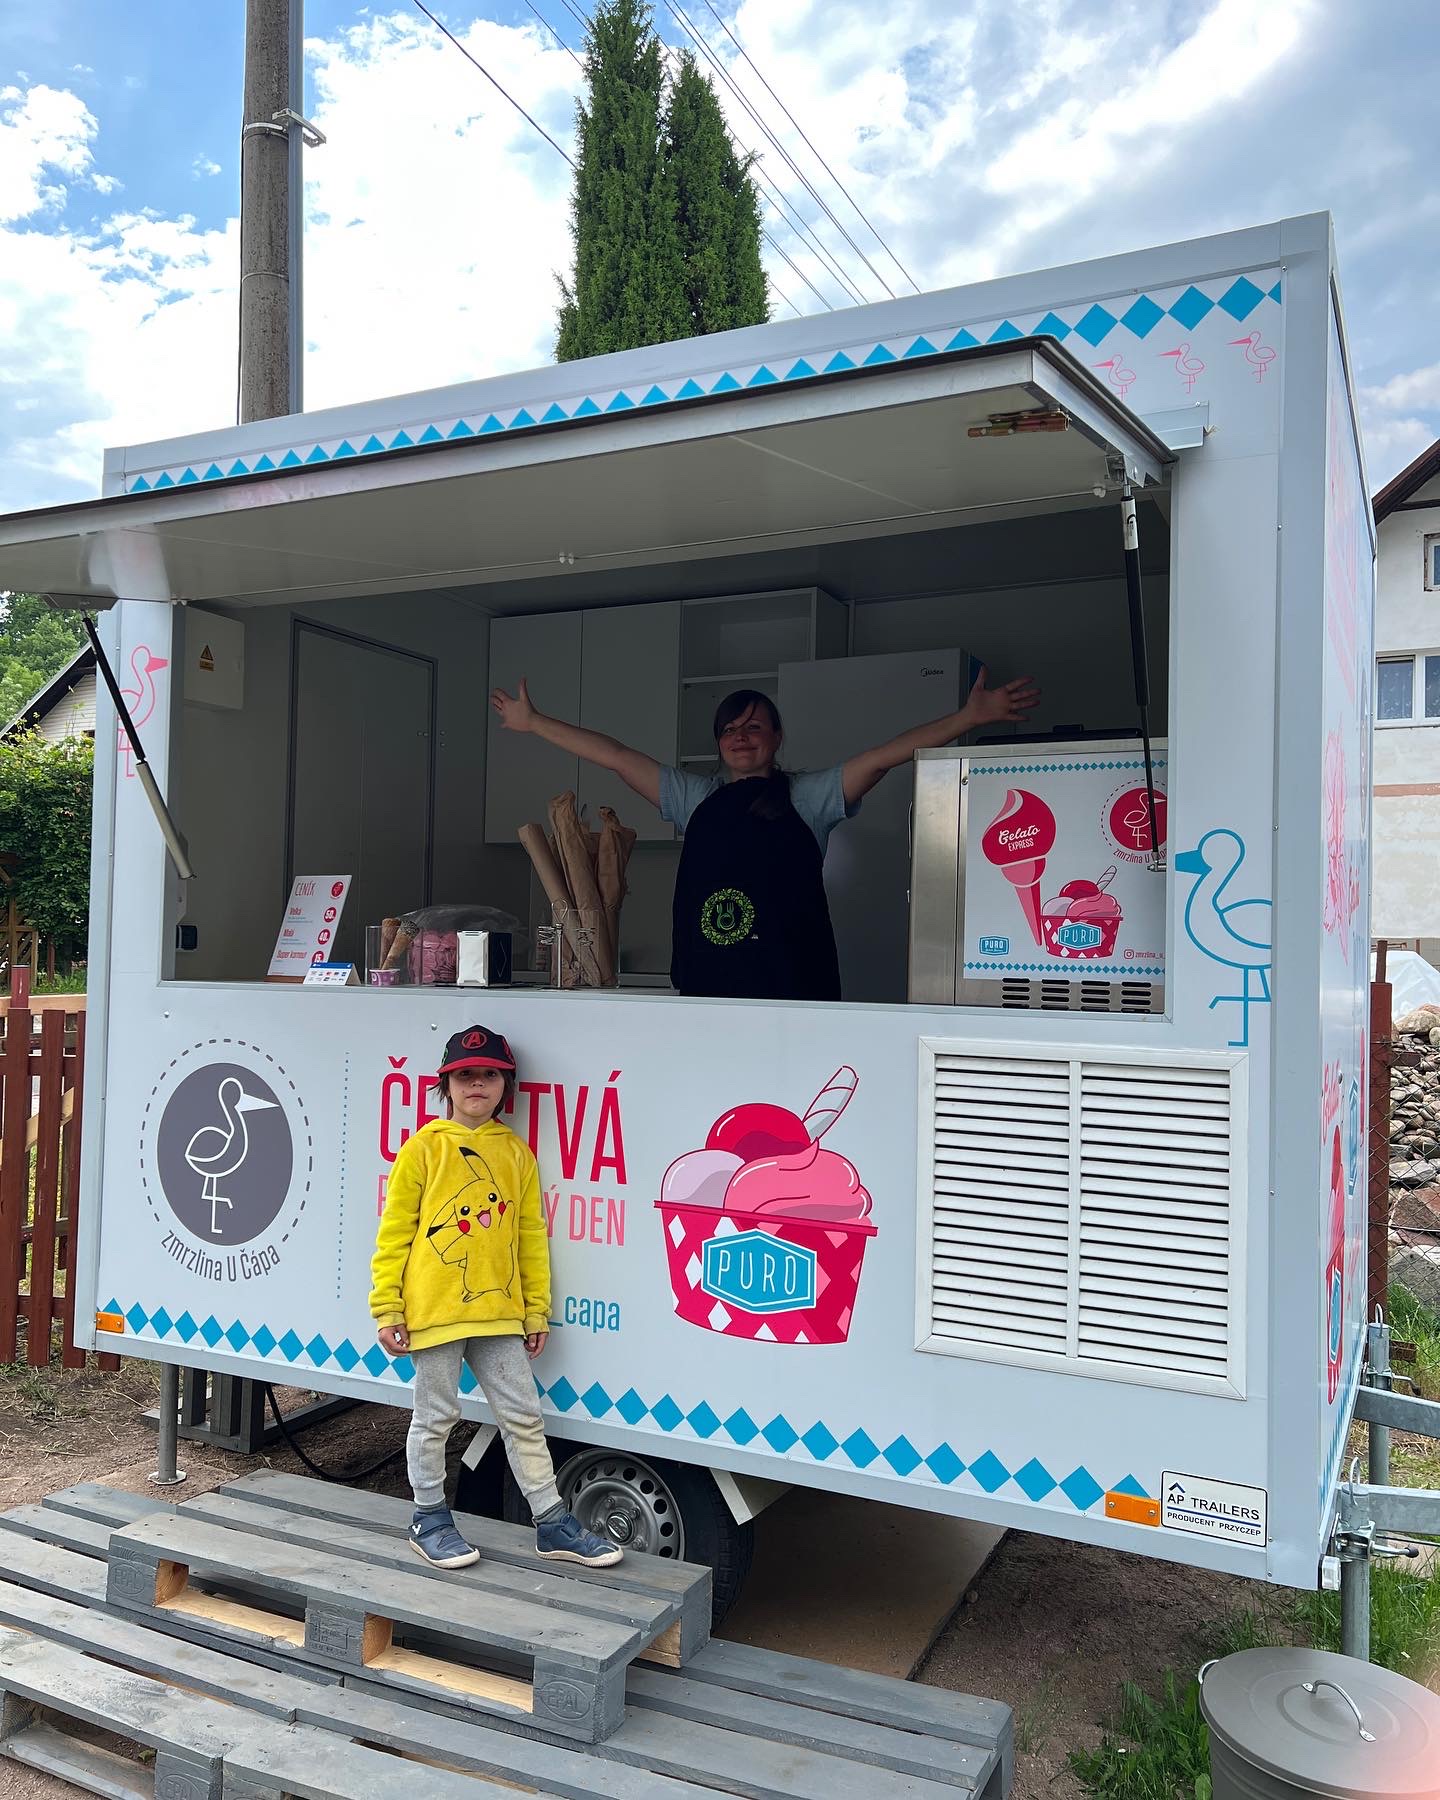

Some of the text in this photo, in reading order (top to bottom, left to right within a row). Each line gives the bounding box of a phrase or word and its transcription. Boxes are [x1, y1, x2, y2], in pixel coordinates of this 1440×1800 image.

[998, 824, 1041, 845] Gelato
[1008, 838, 1034, 852] EXPRESS
[1113, 848, 1143, 864] zmrzlina
[984, 940, 1004, 949] PURO
[1063, 928, 1095, 943] PURO
[569, 1194, 626, 1247] DEN
[161, 1229, 281, 1282] zmrzlina U Čápa
[717, 1249, 797, 1295] PURO
[1167, 1493, 1260, 1520] AP TRAILERS
[1167, 1511, 1262, 1536] PRODUCENT PRZYCZEP
